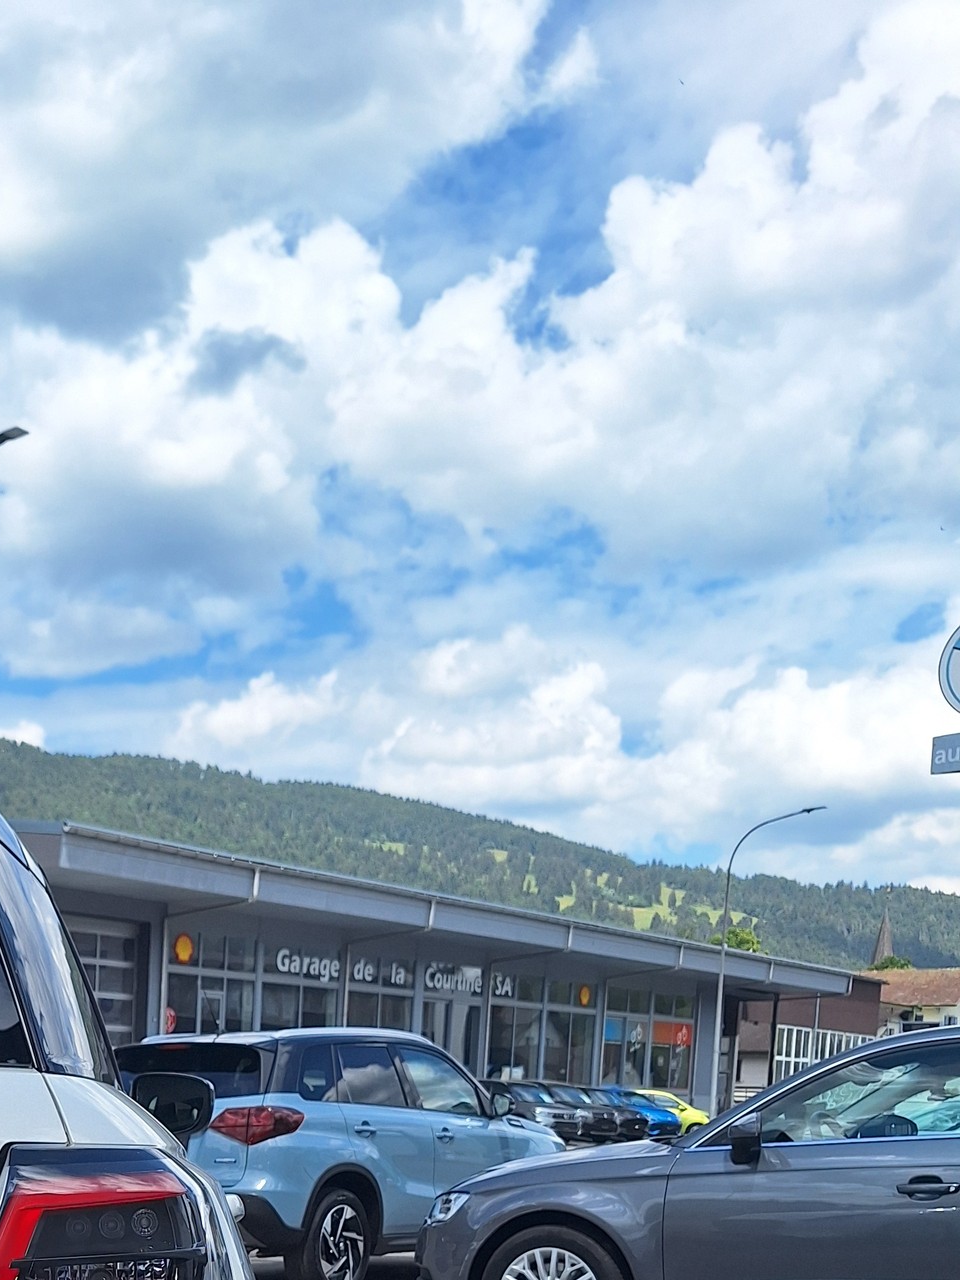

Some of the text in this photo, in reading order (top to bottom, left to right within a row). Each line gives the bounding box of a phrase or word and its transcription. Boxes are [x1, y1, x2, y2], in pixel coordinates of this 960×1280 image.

[276, 948, 512, 997] Garage de la Courtine SA
